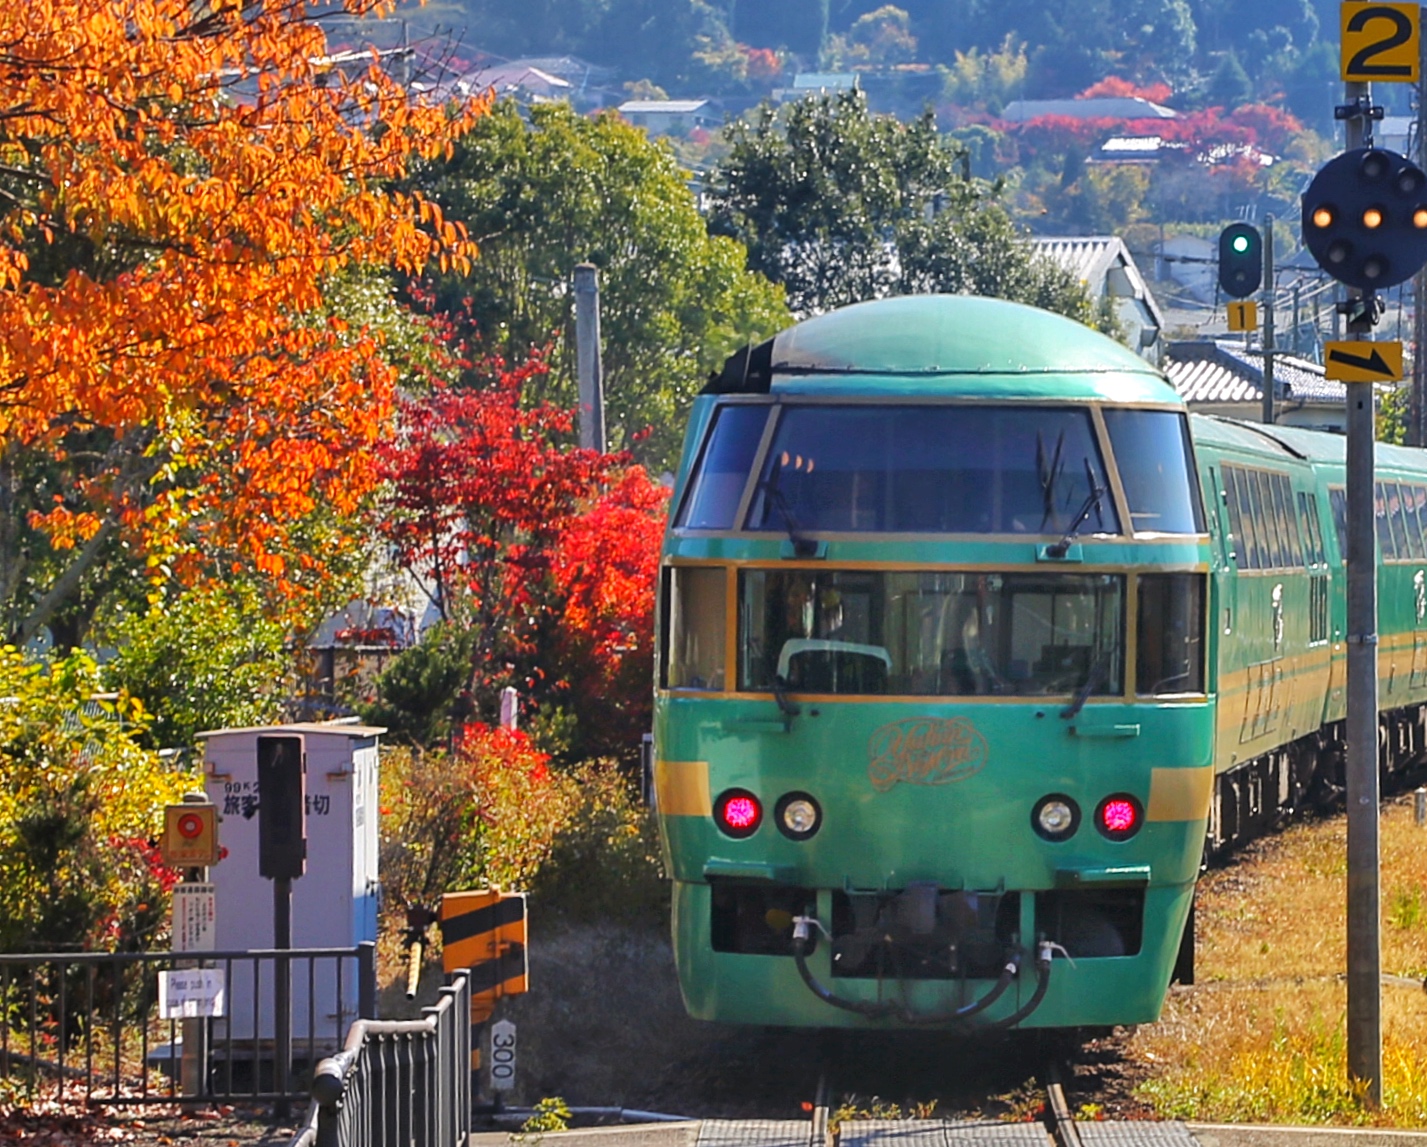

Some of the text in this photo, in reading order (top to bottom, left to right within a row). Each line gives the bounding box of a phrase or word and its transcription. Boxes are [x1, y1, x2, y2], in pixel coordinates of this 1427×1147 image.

[1346, 7, 1413, 77] 2
[1237, 305, 1245, 329] 1
[492, 1033, 515, 1079] 300
